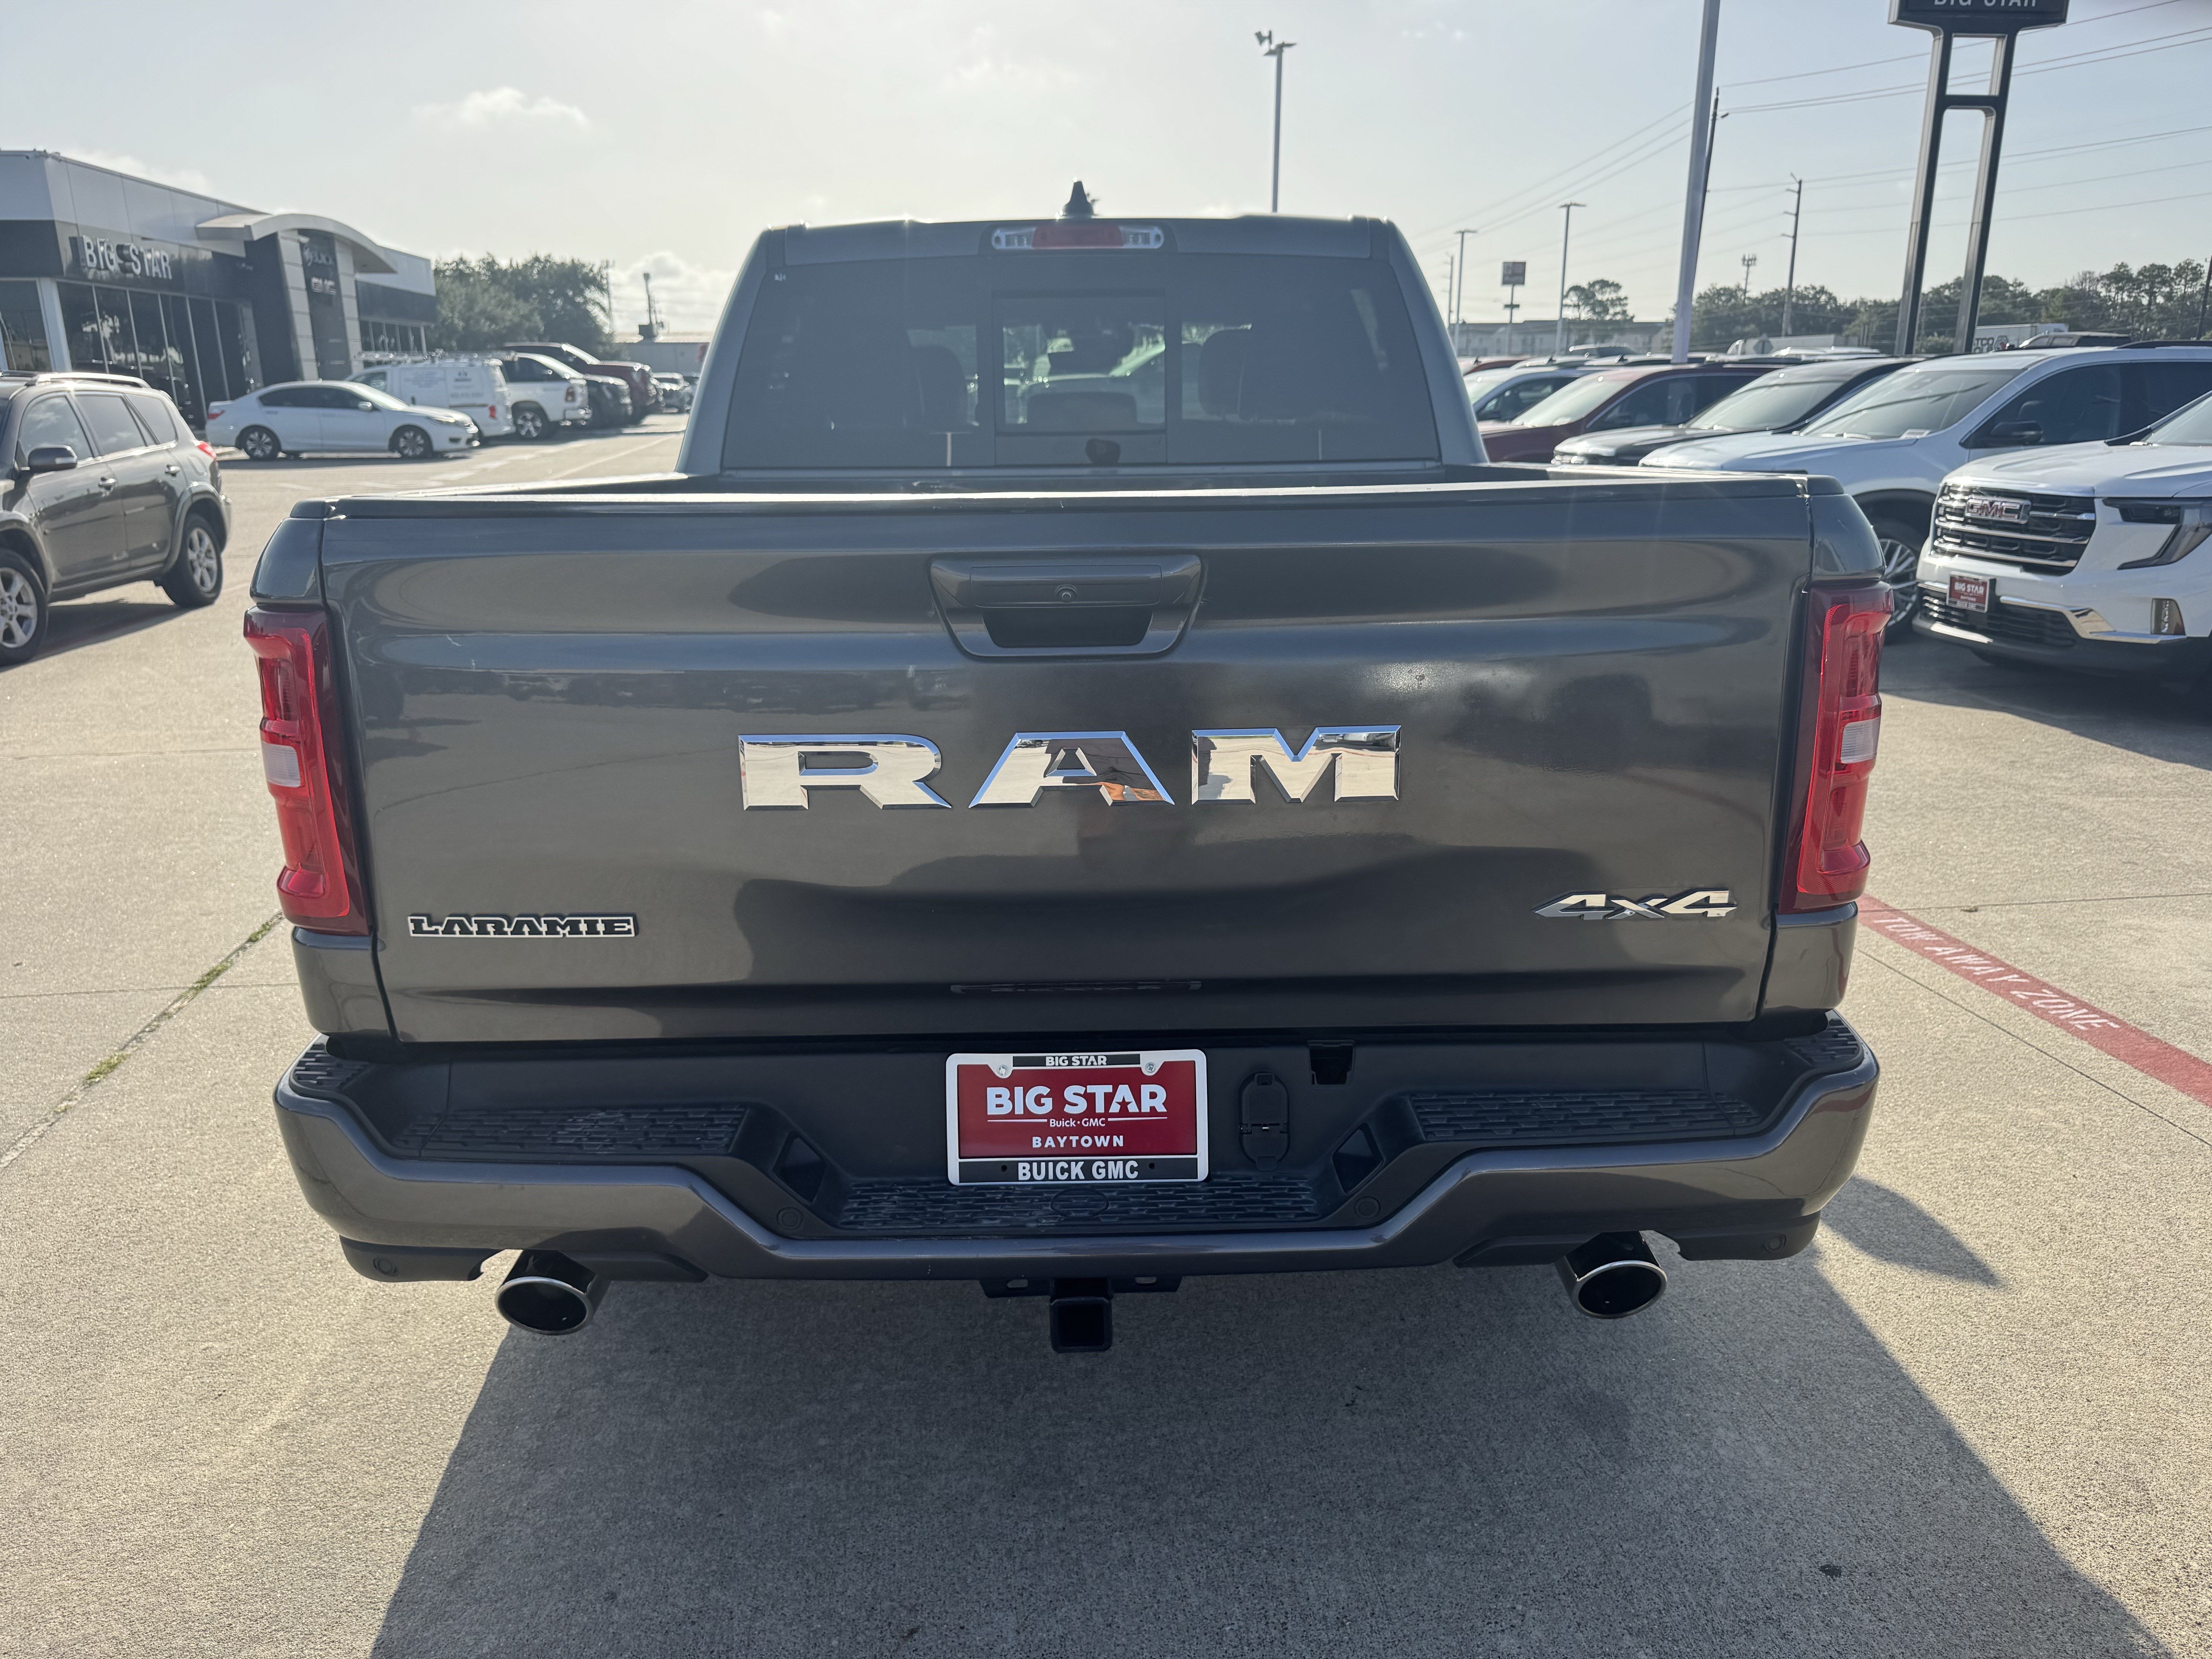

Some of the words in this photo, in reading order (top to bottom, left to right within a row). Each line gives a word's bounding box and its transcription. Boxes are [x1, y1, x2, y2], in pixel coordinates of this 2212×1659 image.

[82, 235, 117, 271] BIG
[129, 243, 173, 280] STAR
[1966, 499, 2020, 519] GMC
[1954, 582, 1966, 592] BIG
[1967, 584, 1984, 595] STAR
[738, 725, 1402, 811] RAM
[1534, 890, 1737, 921] 4x4
[408, 916, 635, 938] LARAMIE
[1874, 917, 1943, 941] TOW
[1923, 946, 2029, 983] AWAY
[2011, 989, 2120, 1030] ZONE
[1046, 1056, 1069, 1066] BIG
[1072, 1055, 1107, 1066] STAR
[987, 1086, 1053, 1115] BIG
[1064, 1085, 1167, 1113] STAR
[1032, 1135, 1123, 1148] BAYTOWN
[1018, 1162, 1085, 1180] BUICK
[1092, 1160, 1138, 1179] GMC
